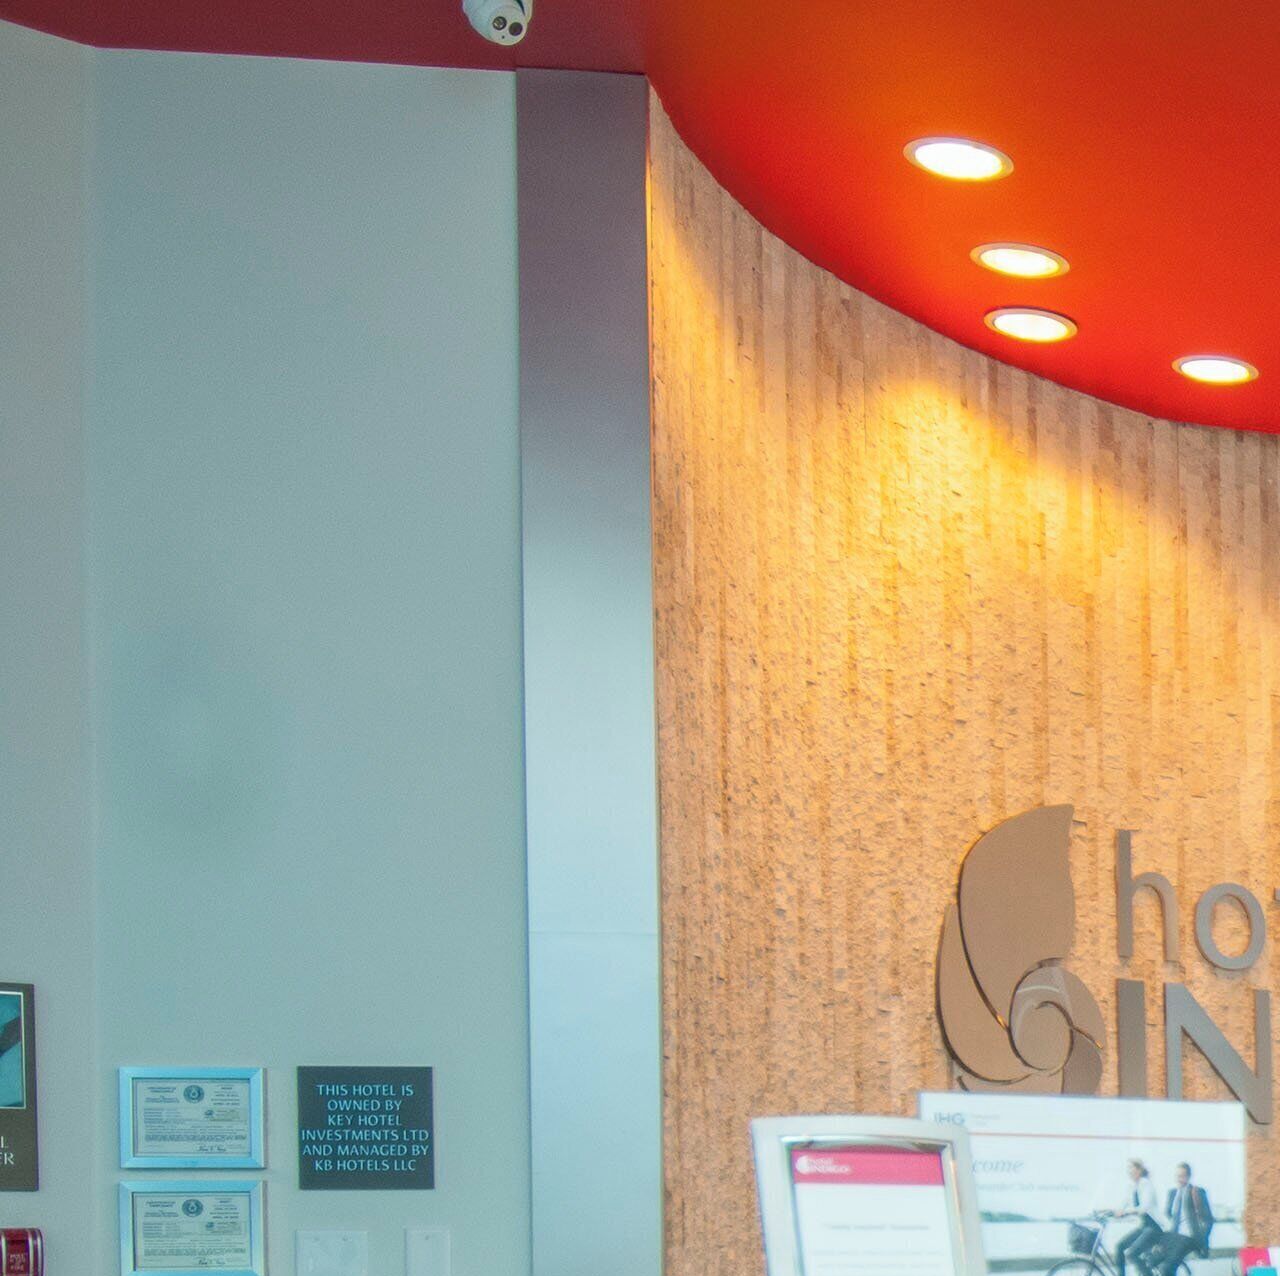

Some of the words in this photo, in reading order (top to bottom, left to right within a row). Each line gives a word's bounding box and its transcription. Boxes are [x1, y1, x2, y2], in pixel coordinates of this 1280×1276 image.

[316, 1084, 348, 1096] THIS
[352, 1084, 396, 1096] HOTEL
[401, 1084, 414, 1096] IS
[327, 1099, 381, 1111] OWNED
[385, 1099, 402, 1111] BY
[327, 1114, 354, 1126] KEY
[358, 1114, 402, 1126] HOTEL
[301, 1129, 399, 1141] INVESTMENTS
[403, 1129, 429, 1141] LTD
[302, 1144, 333, 1156] AND
[337, 1144, 408, 1156] MANAGED
[411, 1144, 429, 1156] BY
[314, 1159, 333, 1171] KB
[336, 1159, 390, 1171] HOTELS
[394, 1159, 416, 1171] LLC
[971, 1159, 1026, 1174] come
